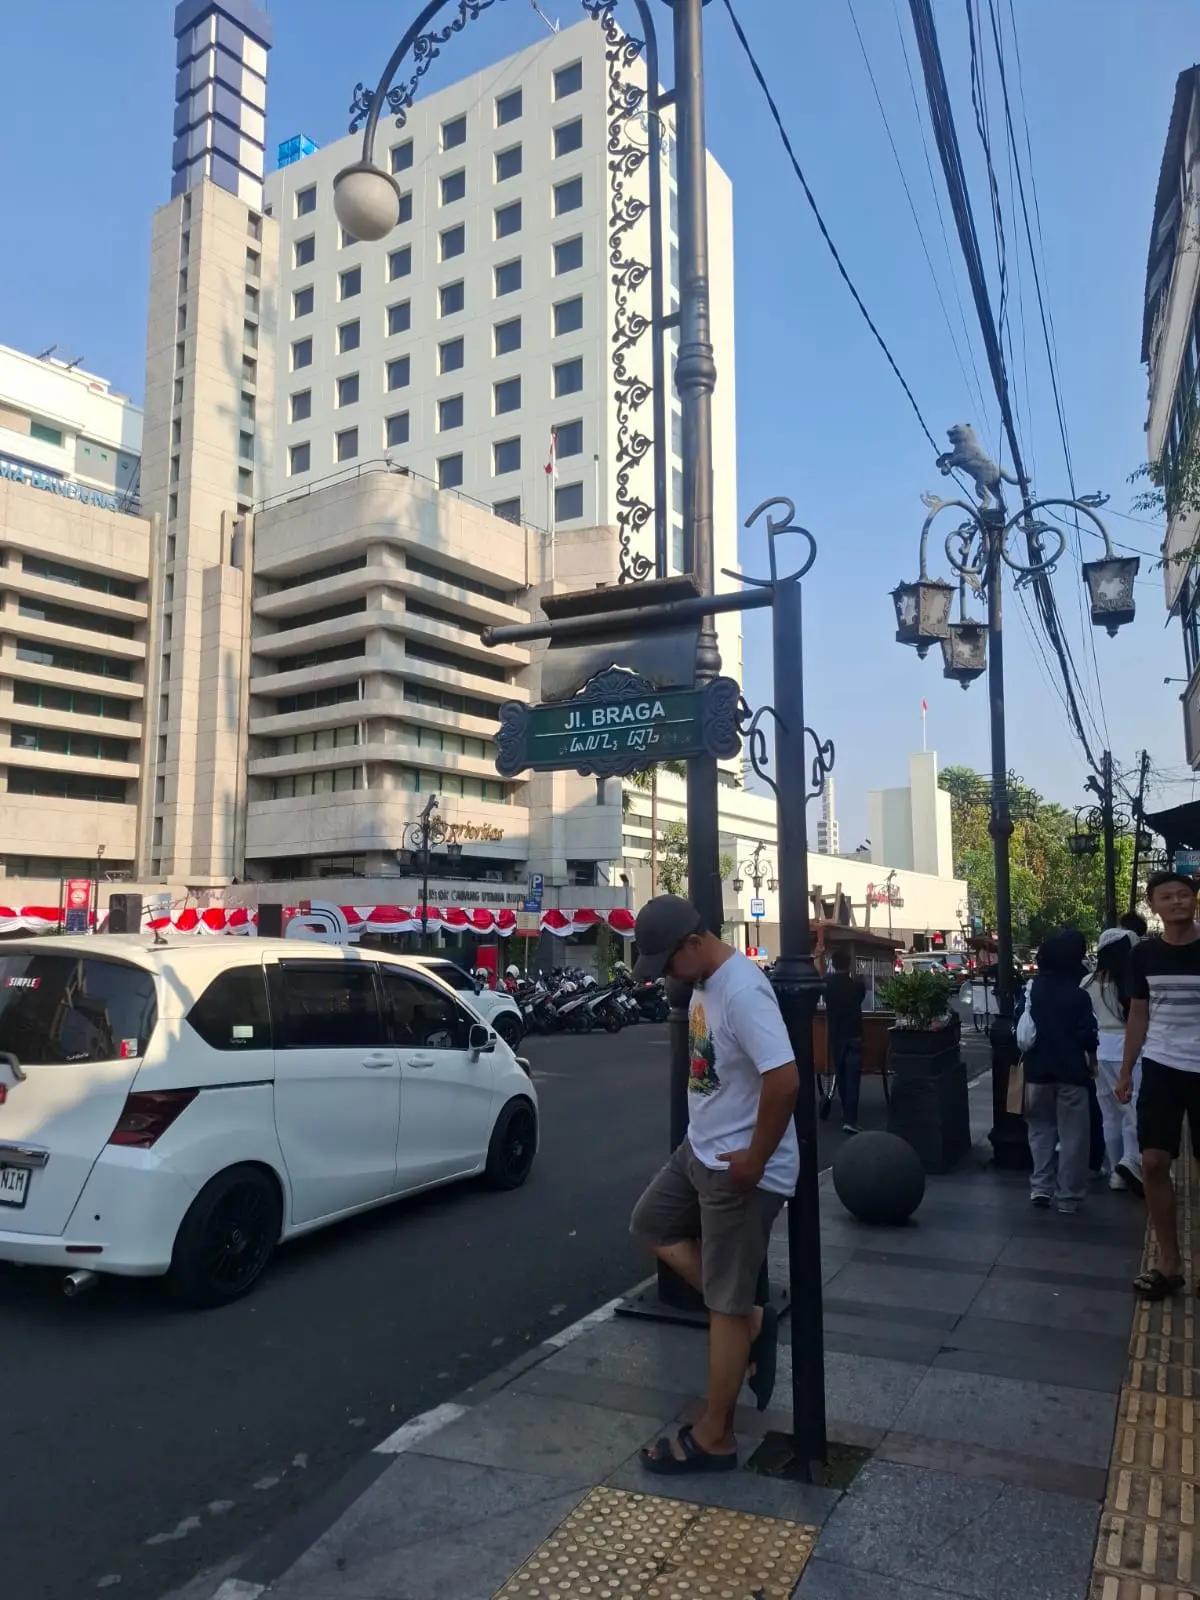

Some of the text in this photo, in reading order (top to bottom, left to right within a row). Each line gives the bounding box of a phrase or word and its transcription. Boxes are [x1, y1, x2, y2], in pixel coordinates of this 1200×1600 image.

[592, 701, 665, 725] BRAGA
[9, 977, 36, 987] SIMPLE
[1, 1170, 24, 1192] NIM
